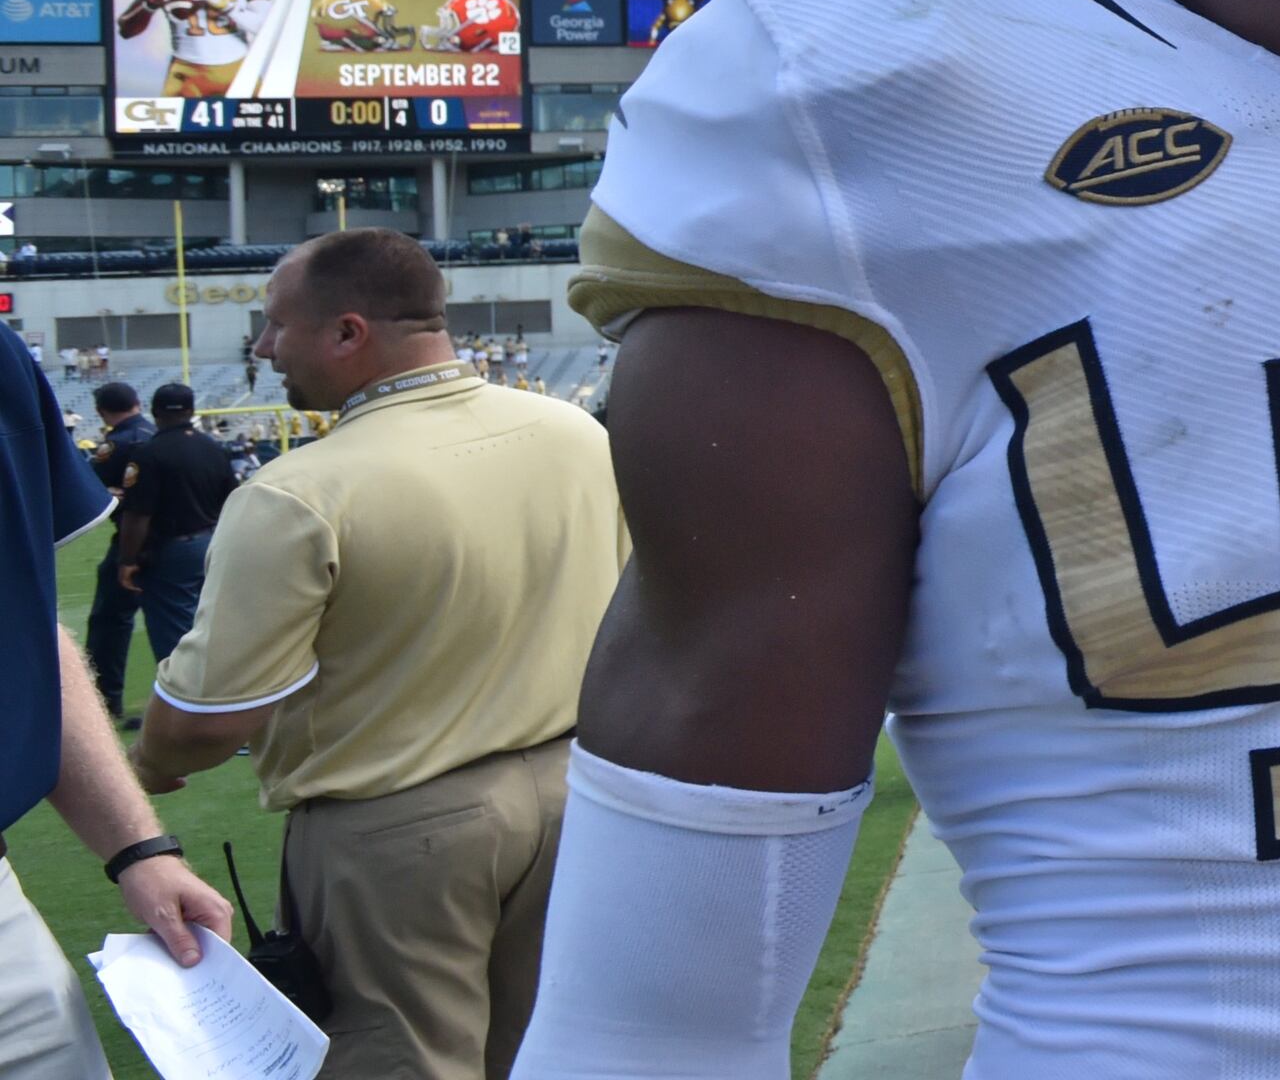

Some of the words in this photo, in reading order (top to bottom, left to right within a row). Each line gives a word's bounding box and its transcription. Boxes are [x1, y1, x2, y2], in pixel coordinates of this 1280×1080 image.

[39, 2, 94, 18] AT&T
[549, 15, 605, 31] Georgia
[556, 28, 600, 41] Power
[339, 63, 467, 87] SEPTEMBER
[471, 63, 500, 87] 22
[191, 100, 224, 127] 41
[330, 100, 382, 126] 0:00
[395, 110, 407, 127] 4
[431, 99, 448, 126] 0
[267, 115, 284, 128] 41
[143, 143, 230, 155] NATIONAL
[240, 140, 342, 154] CHAMPIONS
[471, 138, 507, 151] 1990
[1077, 121, 1201, 180] ACC
[394, 372, 438, 390] GEORGIA
